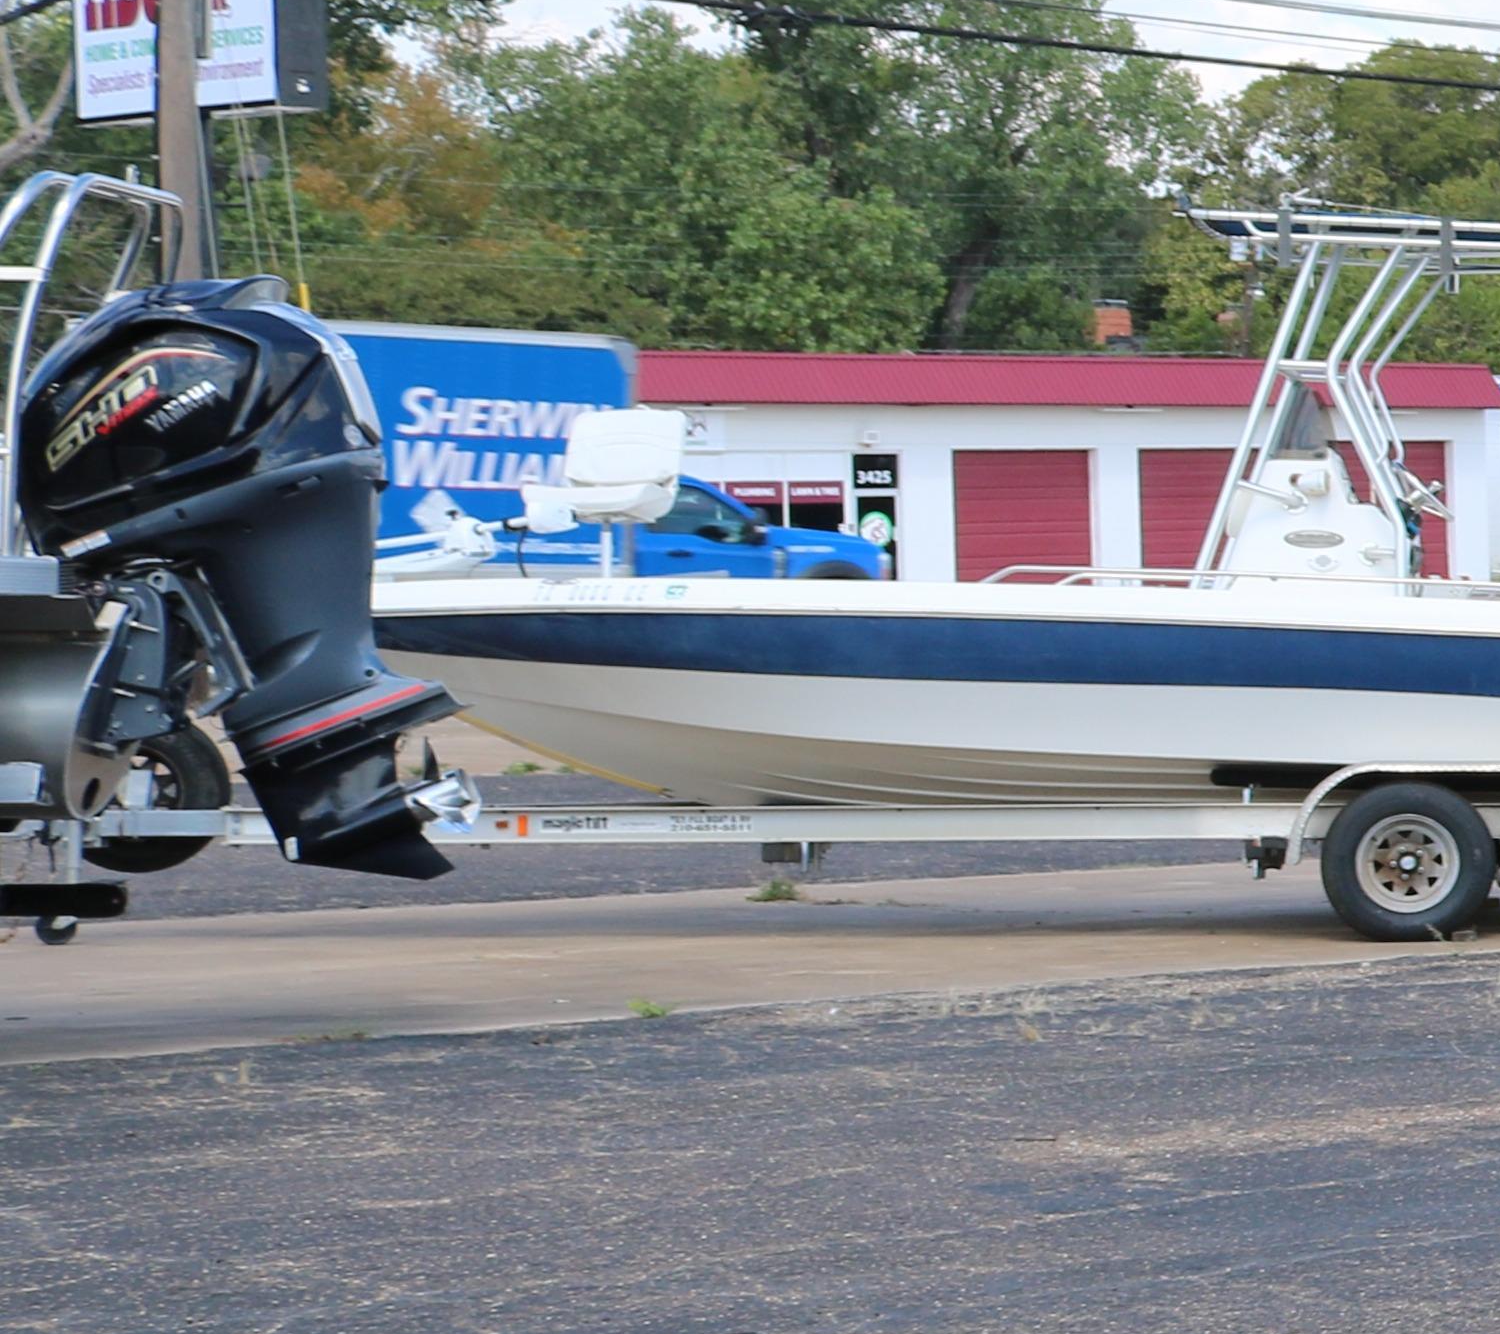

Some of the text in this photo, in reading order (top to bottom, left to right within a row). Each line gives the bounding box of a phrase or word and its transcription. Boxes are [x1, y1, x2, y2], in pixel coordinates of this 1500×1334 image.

[88, 71, 147, 95] Specialists
[197, 58, 264, 82] nvironment
[144, 380, 218, 432] YAMAHA
[395, 386, 615, 440] SHERWI
[392, 439, 568, 491] WILLIA
[857, 470, 893, 485] 3425
